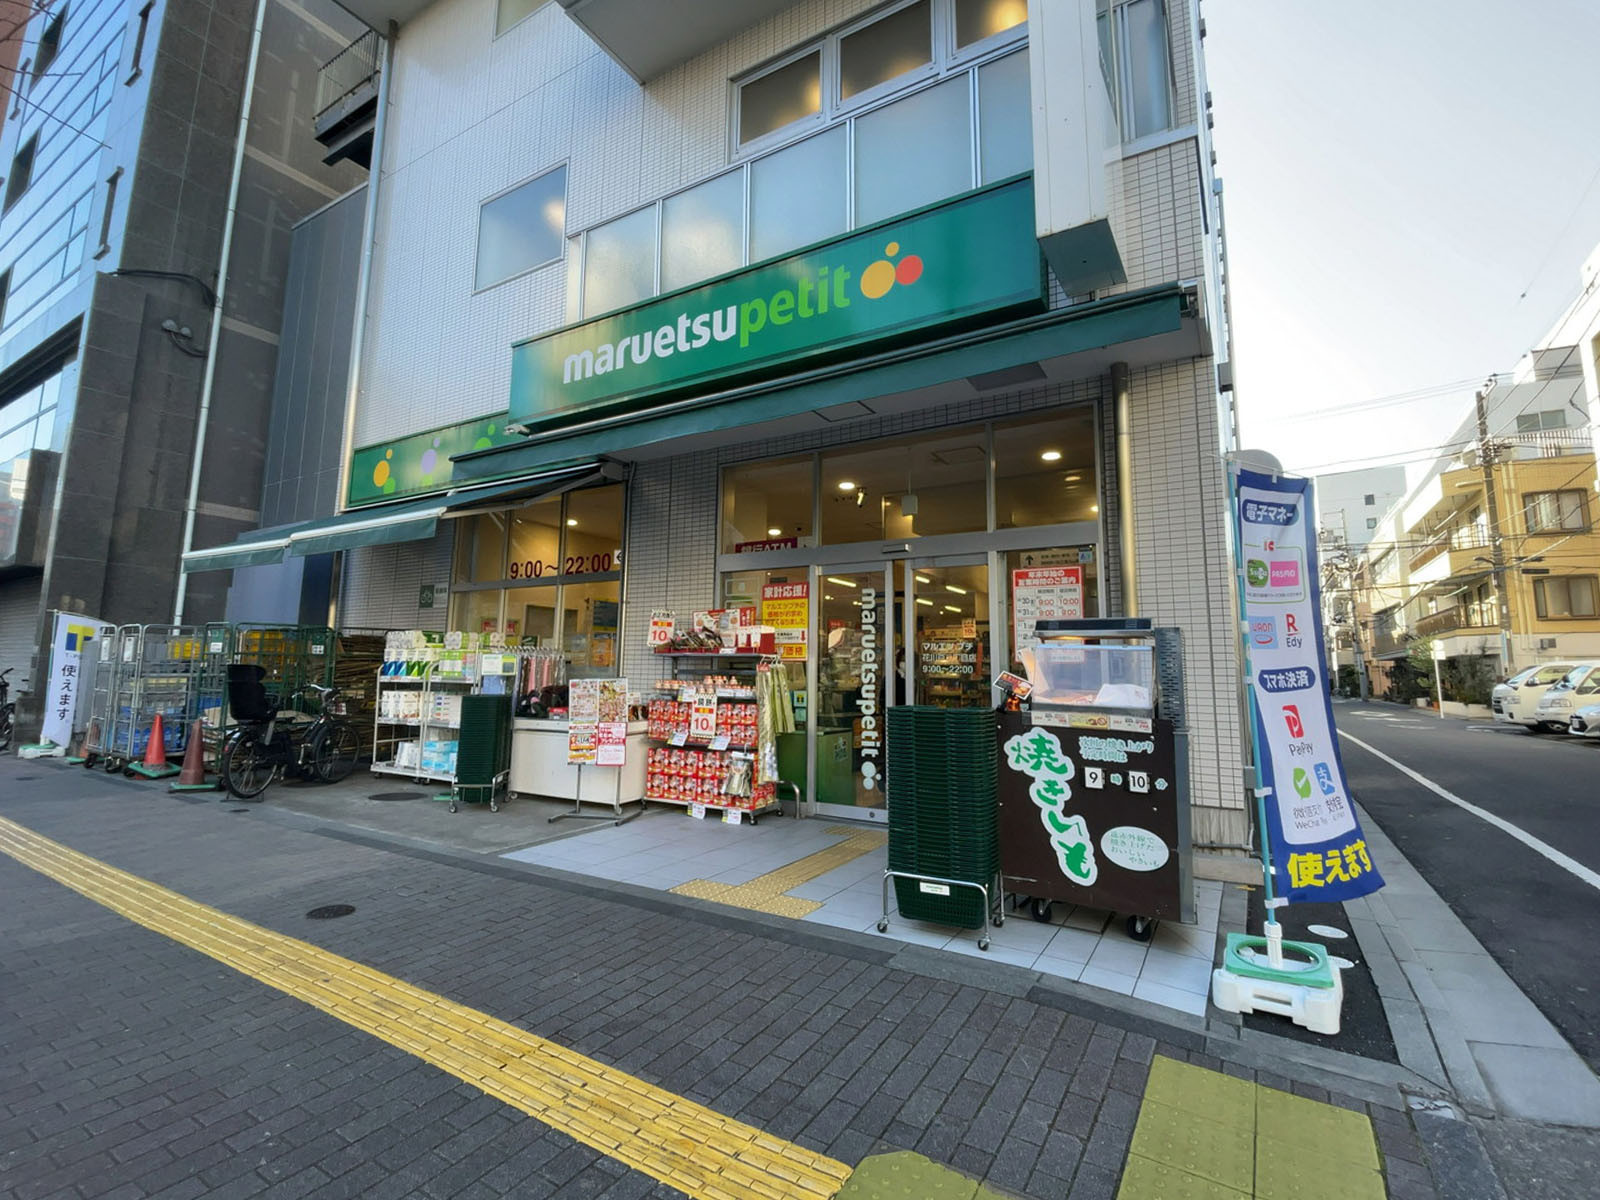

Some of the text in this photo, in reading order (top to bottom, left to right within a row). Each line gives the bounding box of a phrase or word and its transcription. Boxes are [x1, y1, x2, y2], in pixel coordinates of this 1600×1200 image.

[1246, 502, 1294, 523] 電子マネー
[1286, 636, 1302, 648] Edy
[1263, 670, 1309, 690] スマホ決済
[56, 663, 77, 721] 使えます
[1288, 742, 1313, 757] PayPay
[1089, 771, 1098, 784] 9
[1131, 775, 1145, 789] 10
[1286, 838, 1372, 888] 使えます
